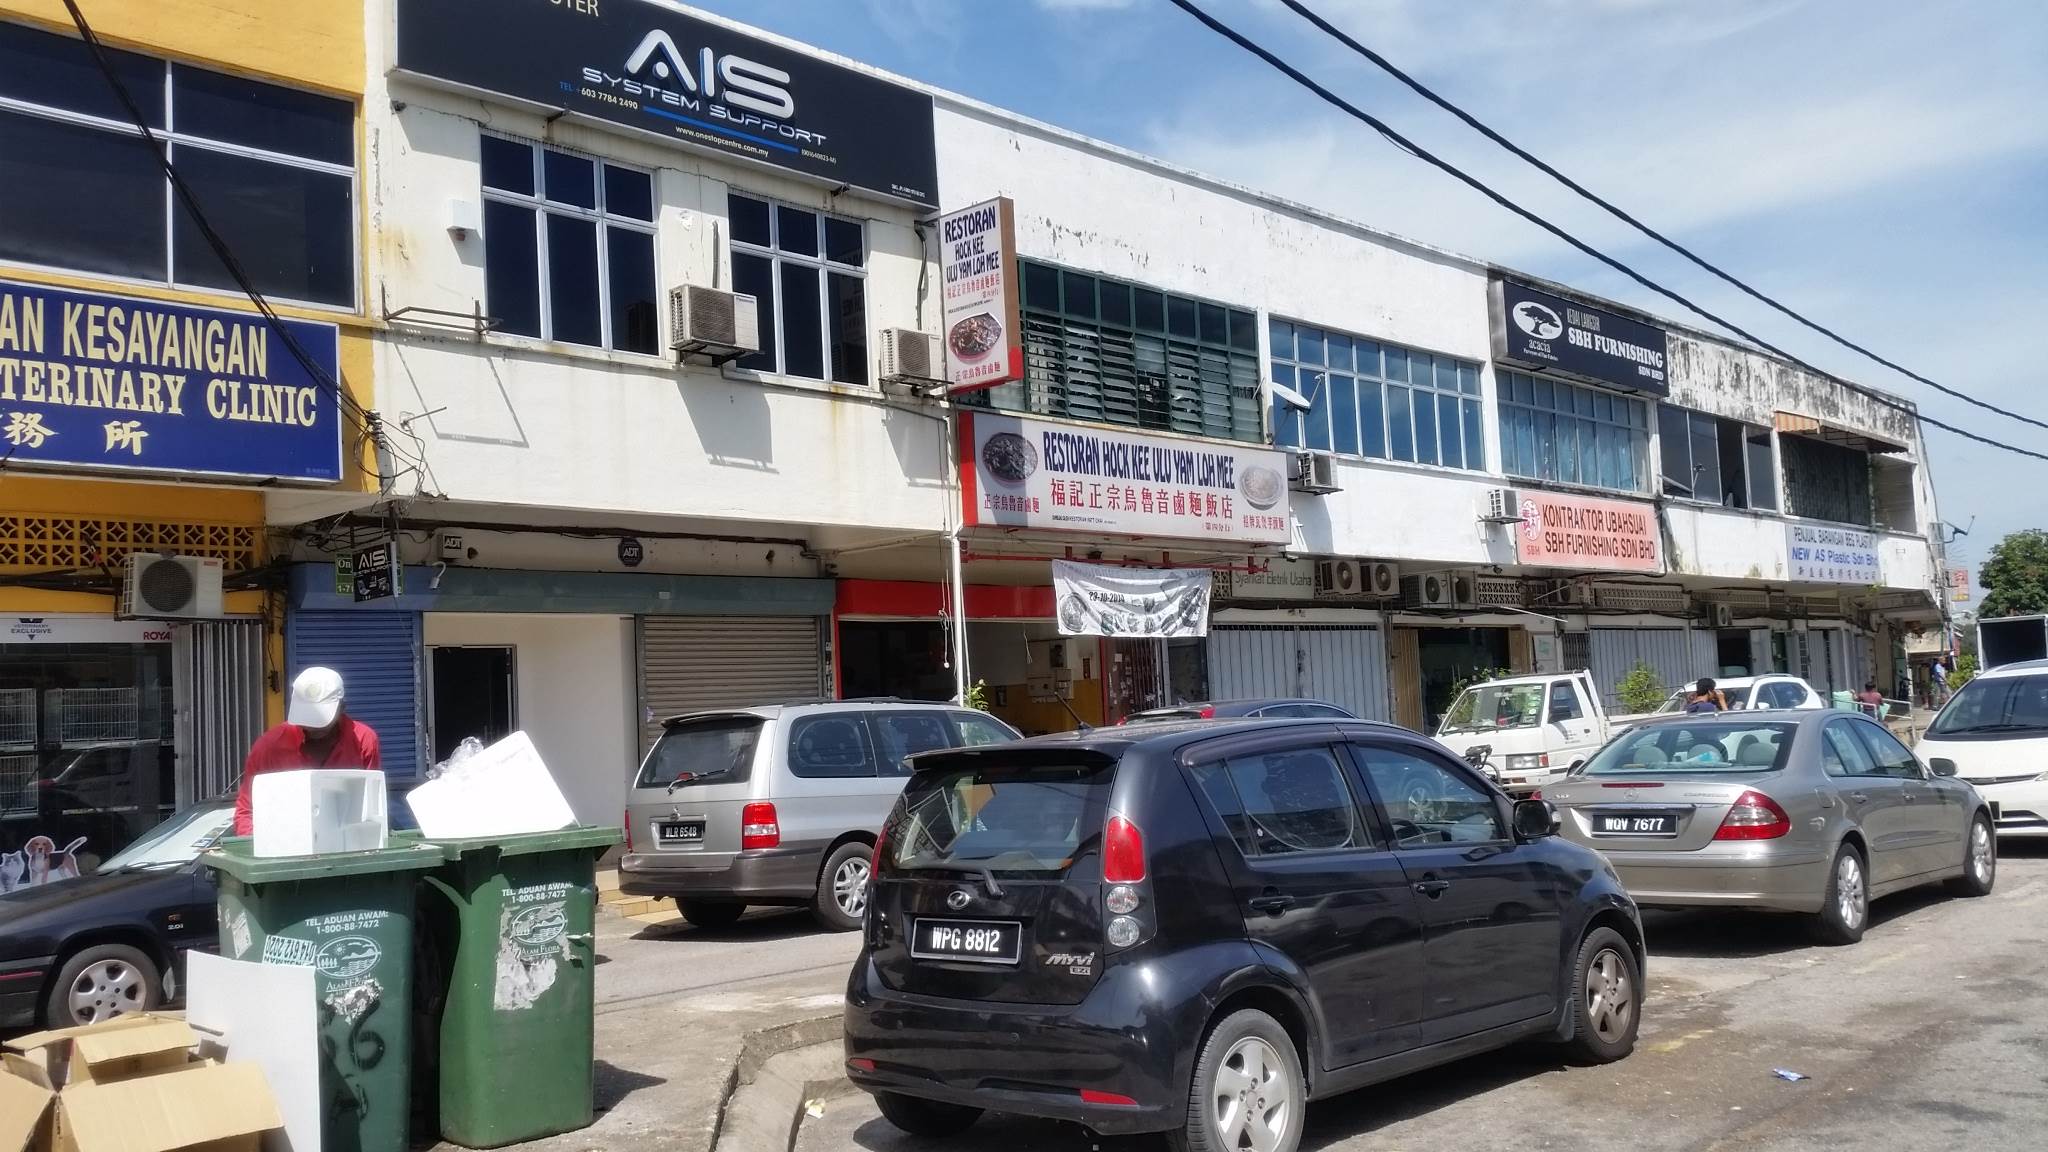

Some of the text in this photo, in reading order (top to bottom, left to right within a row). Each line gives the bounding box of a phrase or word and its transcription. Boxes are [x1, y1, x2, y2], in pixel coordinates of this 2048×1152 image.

[551, 0, 599, 16] ER
[624, 29, 795, 118] AIS
[582, 66, 827, 147] SYSTEM SUPPORT
[598, 91, 618, 105] 7784
[619, 97, 638, 110] 2490
[675, 126, 769, 158] www.onestopcentre.com.my
[944, 205, 996, 244] RESTORAN
[954, 235, 985, 261] HOCK KEE
[946, 250, 999, 283] ULU YAM LOH MEE
[63, 301, 268, 379] KESAYANGAN
[1528, 339, 1551, 354] acacia
[1567, 326, 1593, 350] SBH
[1593, 333, 1664, 368] FURNISHING
[1638, 365, 1664, 381] SDN BHD
[0, 357, 318, 428] TERINARY CLINIC
[1043, 431, 1236, 490] RESTORAN HOCK KEE ULU YAM LOH MEE
[1542, 503, 1603, 532] KONTRAKTOR
[1604, 511, 1647, 535] UBAHSUAI
[444, 537, 461, 548] ADT
[623, 547, 639, 557] ADT
[1545, 531, 1655, 560] SBH FURNISHING SDN BHD
[358, 549, 386, 570] AIS
[1791, 546, 1810, 561] NEW
[1814, 548, 1826, 562] AS
[1828, 550, 1850, 565] Plastic
[1852, 552, 1864, 566] Sdn
[680, 826, 697, 838] 6548
[1604, 817, 1665, 831] WQV 7677
[511, 889, 567, 904] 1-800-88-7472
[518, 884, 547, 894] ADUAN
[316, 919, 379, 934] 1-800-88-7472
[324, 913, 356, 925] ADUAN
[358, 910, 389, 921] AWAM:
[932, 926, 1000, 952] WPG 8812
